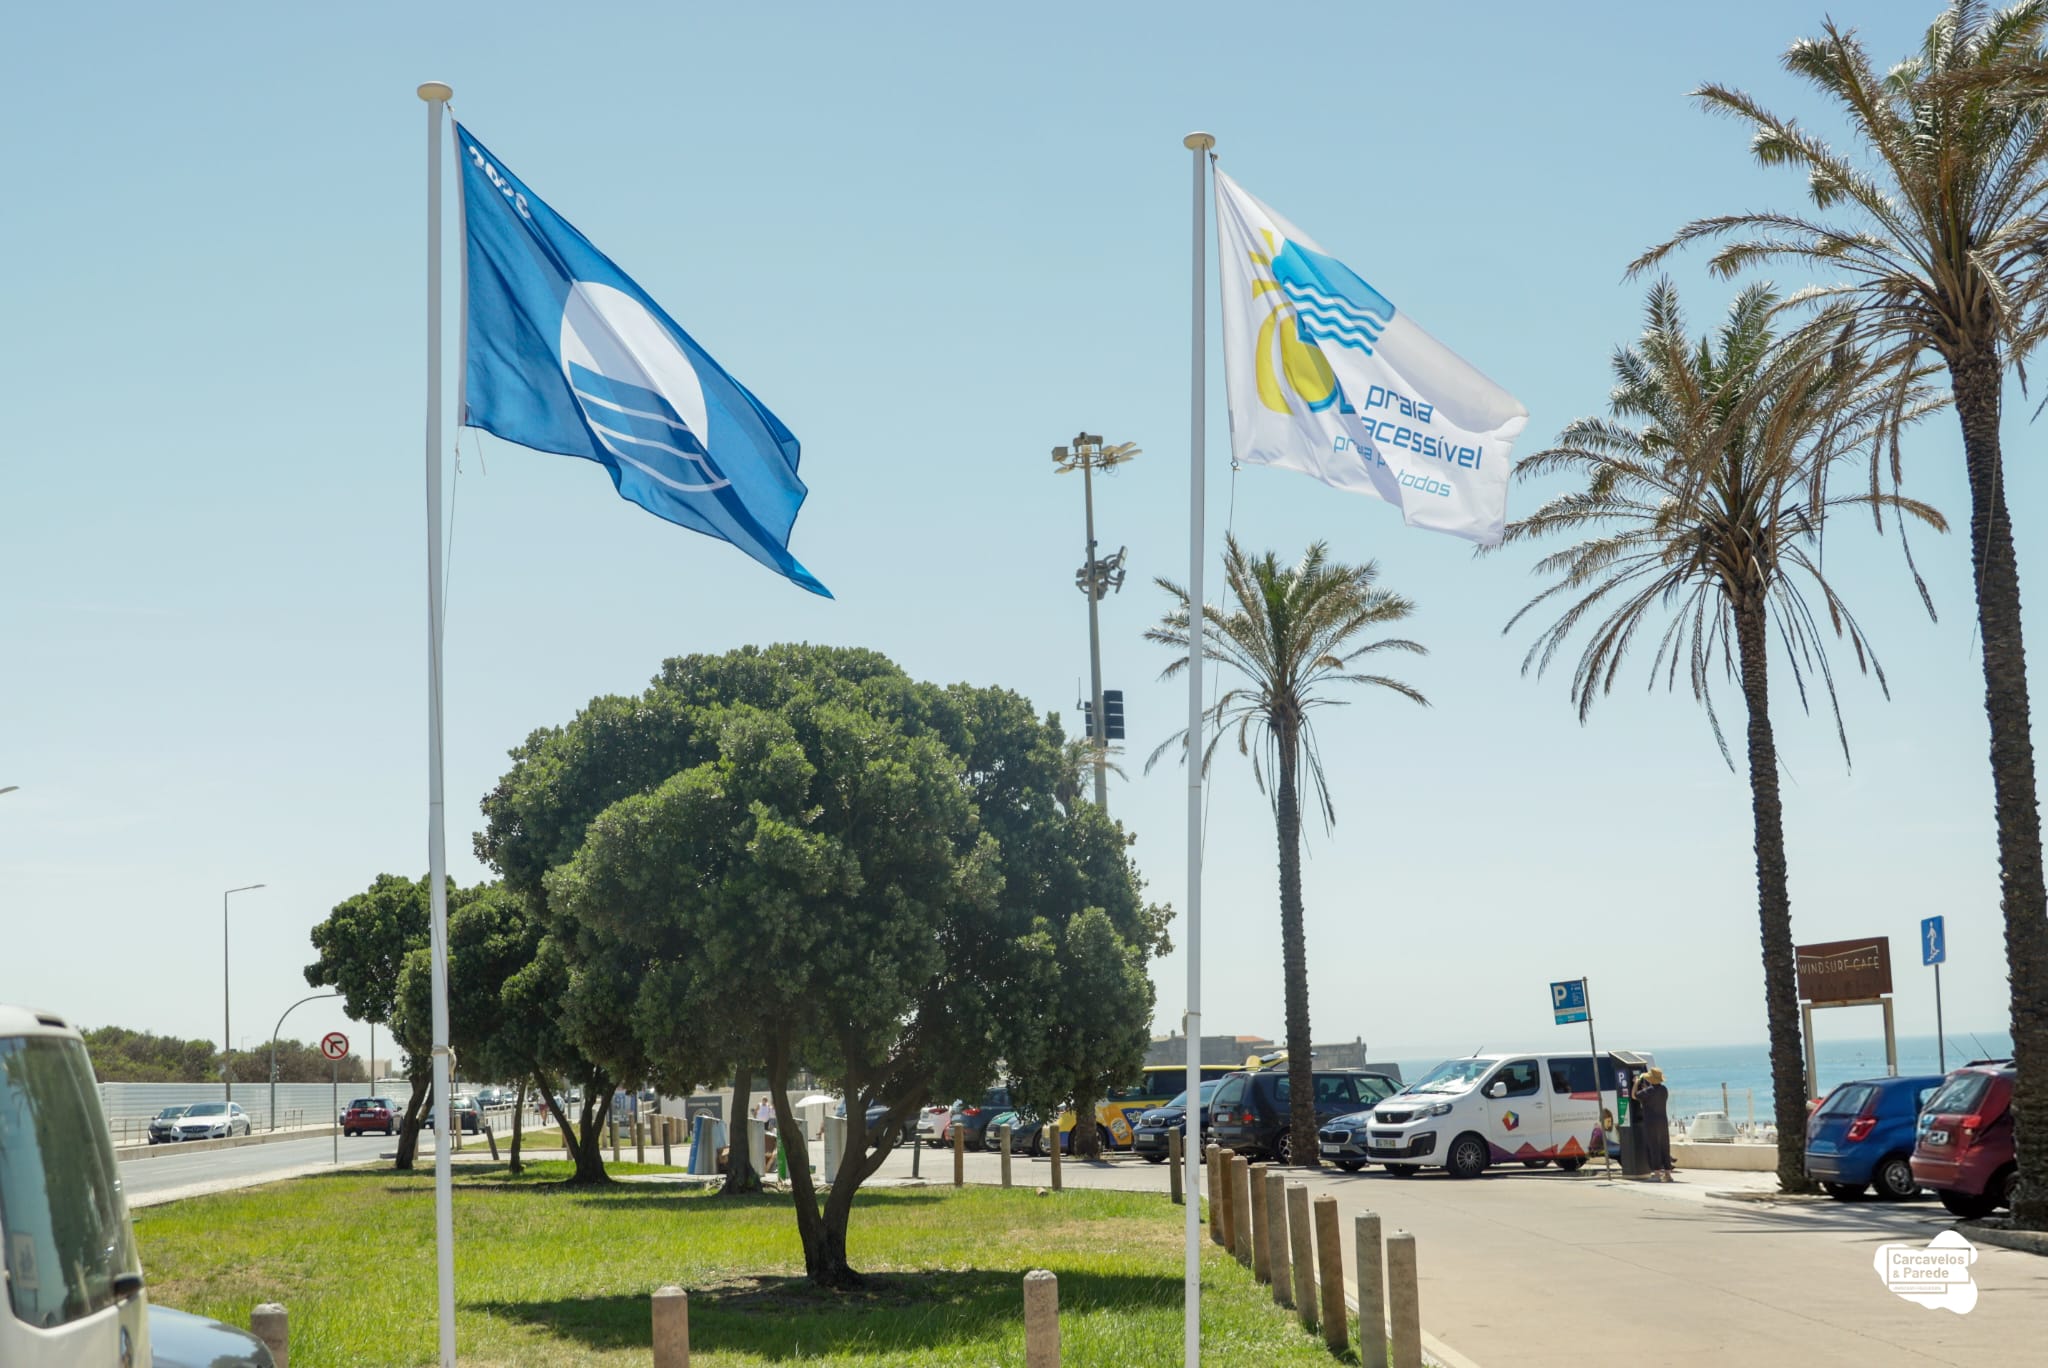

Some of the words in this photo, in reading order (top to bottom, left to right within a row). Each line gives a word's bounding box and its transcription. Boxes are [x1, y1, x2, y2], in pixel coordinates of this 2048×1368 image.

[1364, 384, 1434, 424] praia
[1361, 416, 1482, 470] acessível
[1397, 469, 1451, 497] todos
[1798, 959, 1849, 976] WINDSURF
[1553, 985, 1568, 1007] P
